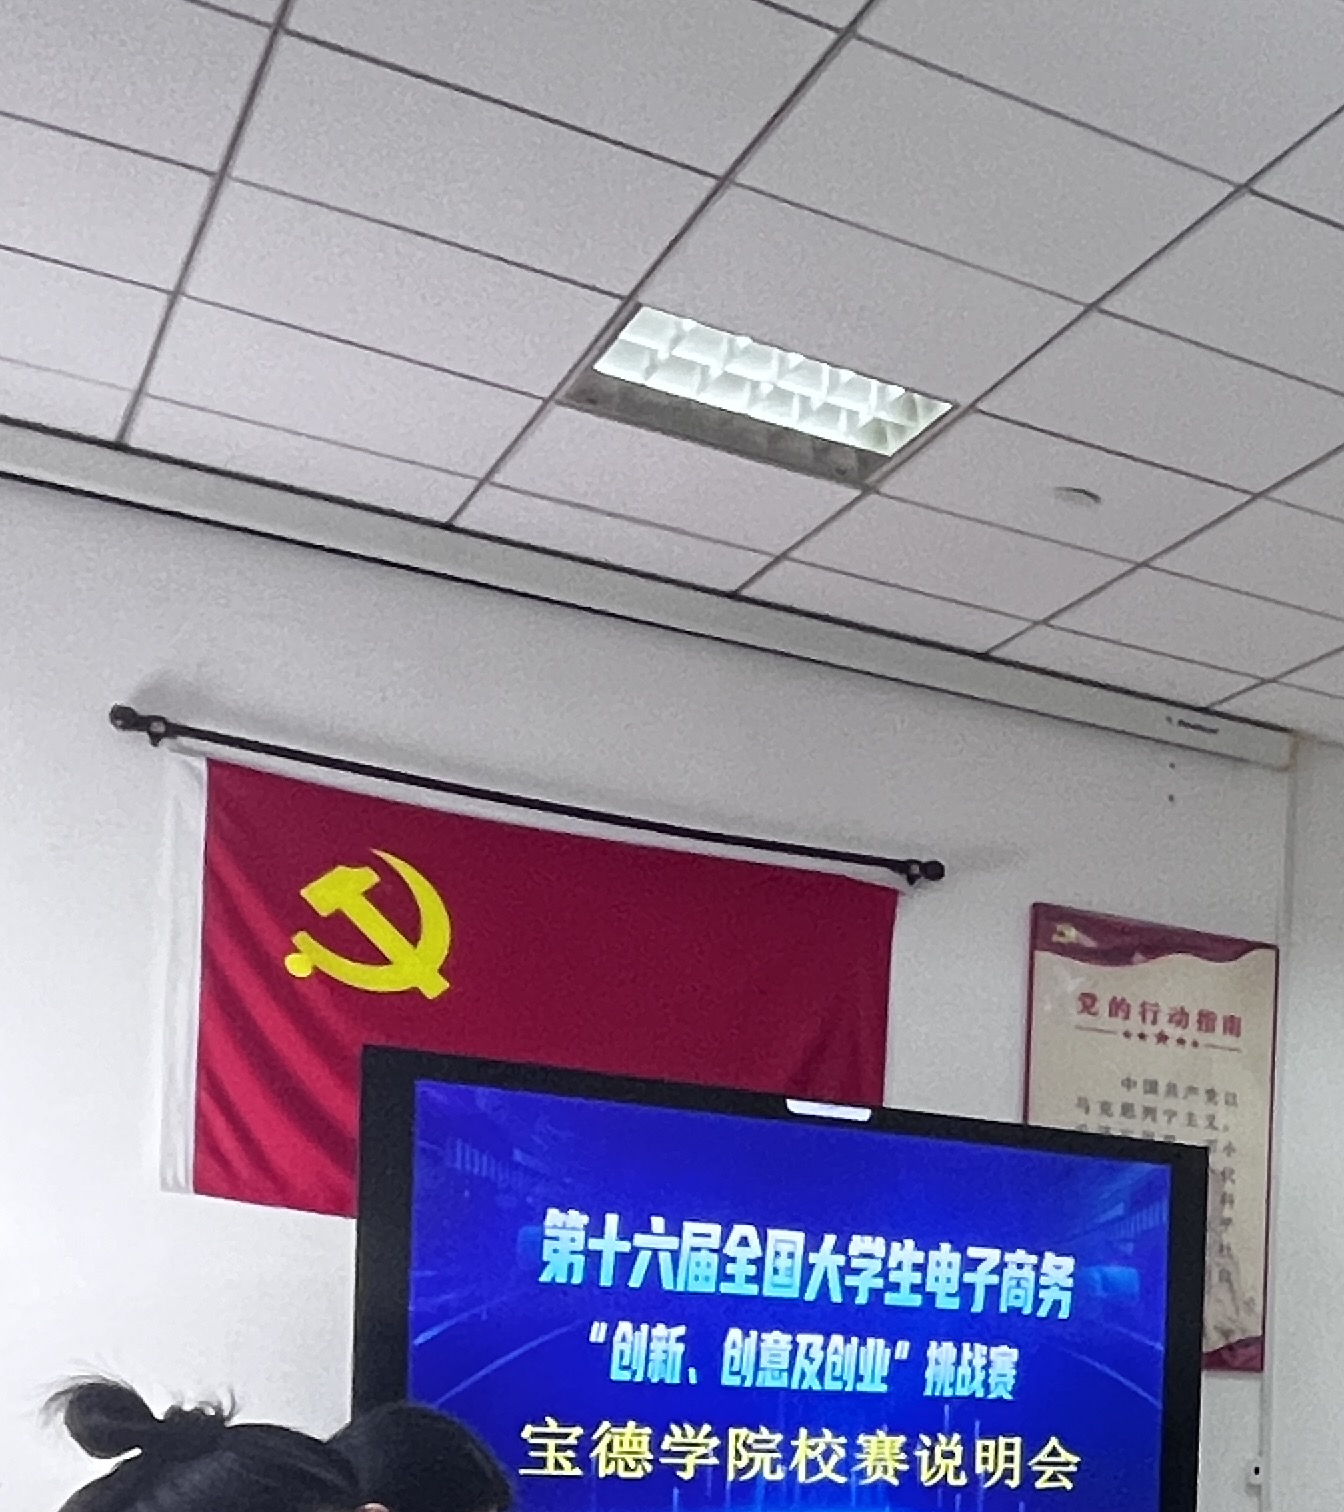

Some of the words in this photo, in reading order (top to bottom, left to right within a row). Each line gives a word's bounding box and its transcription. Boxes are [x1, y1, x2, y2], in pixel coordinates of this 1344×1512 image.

[1076, 991, 1243, 1039] 党的行动指南
[538, 1207, 1076, 1320] 第十六届全国大学生电子商务
[518, 1415, 1082, 1491] 宝德学院校赛说明会
